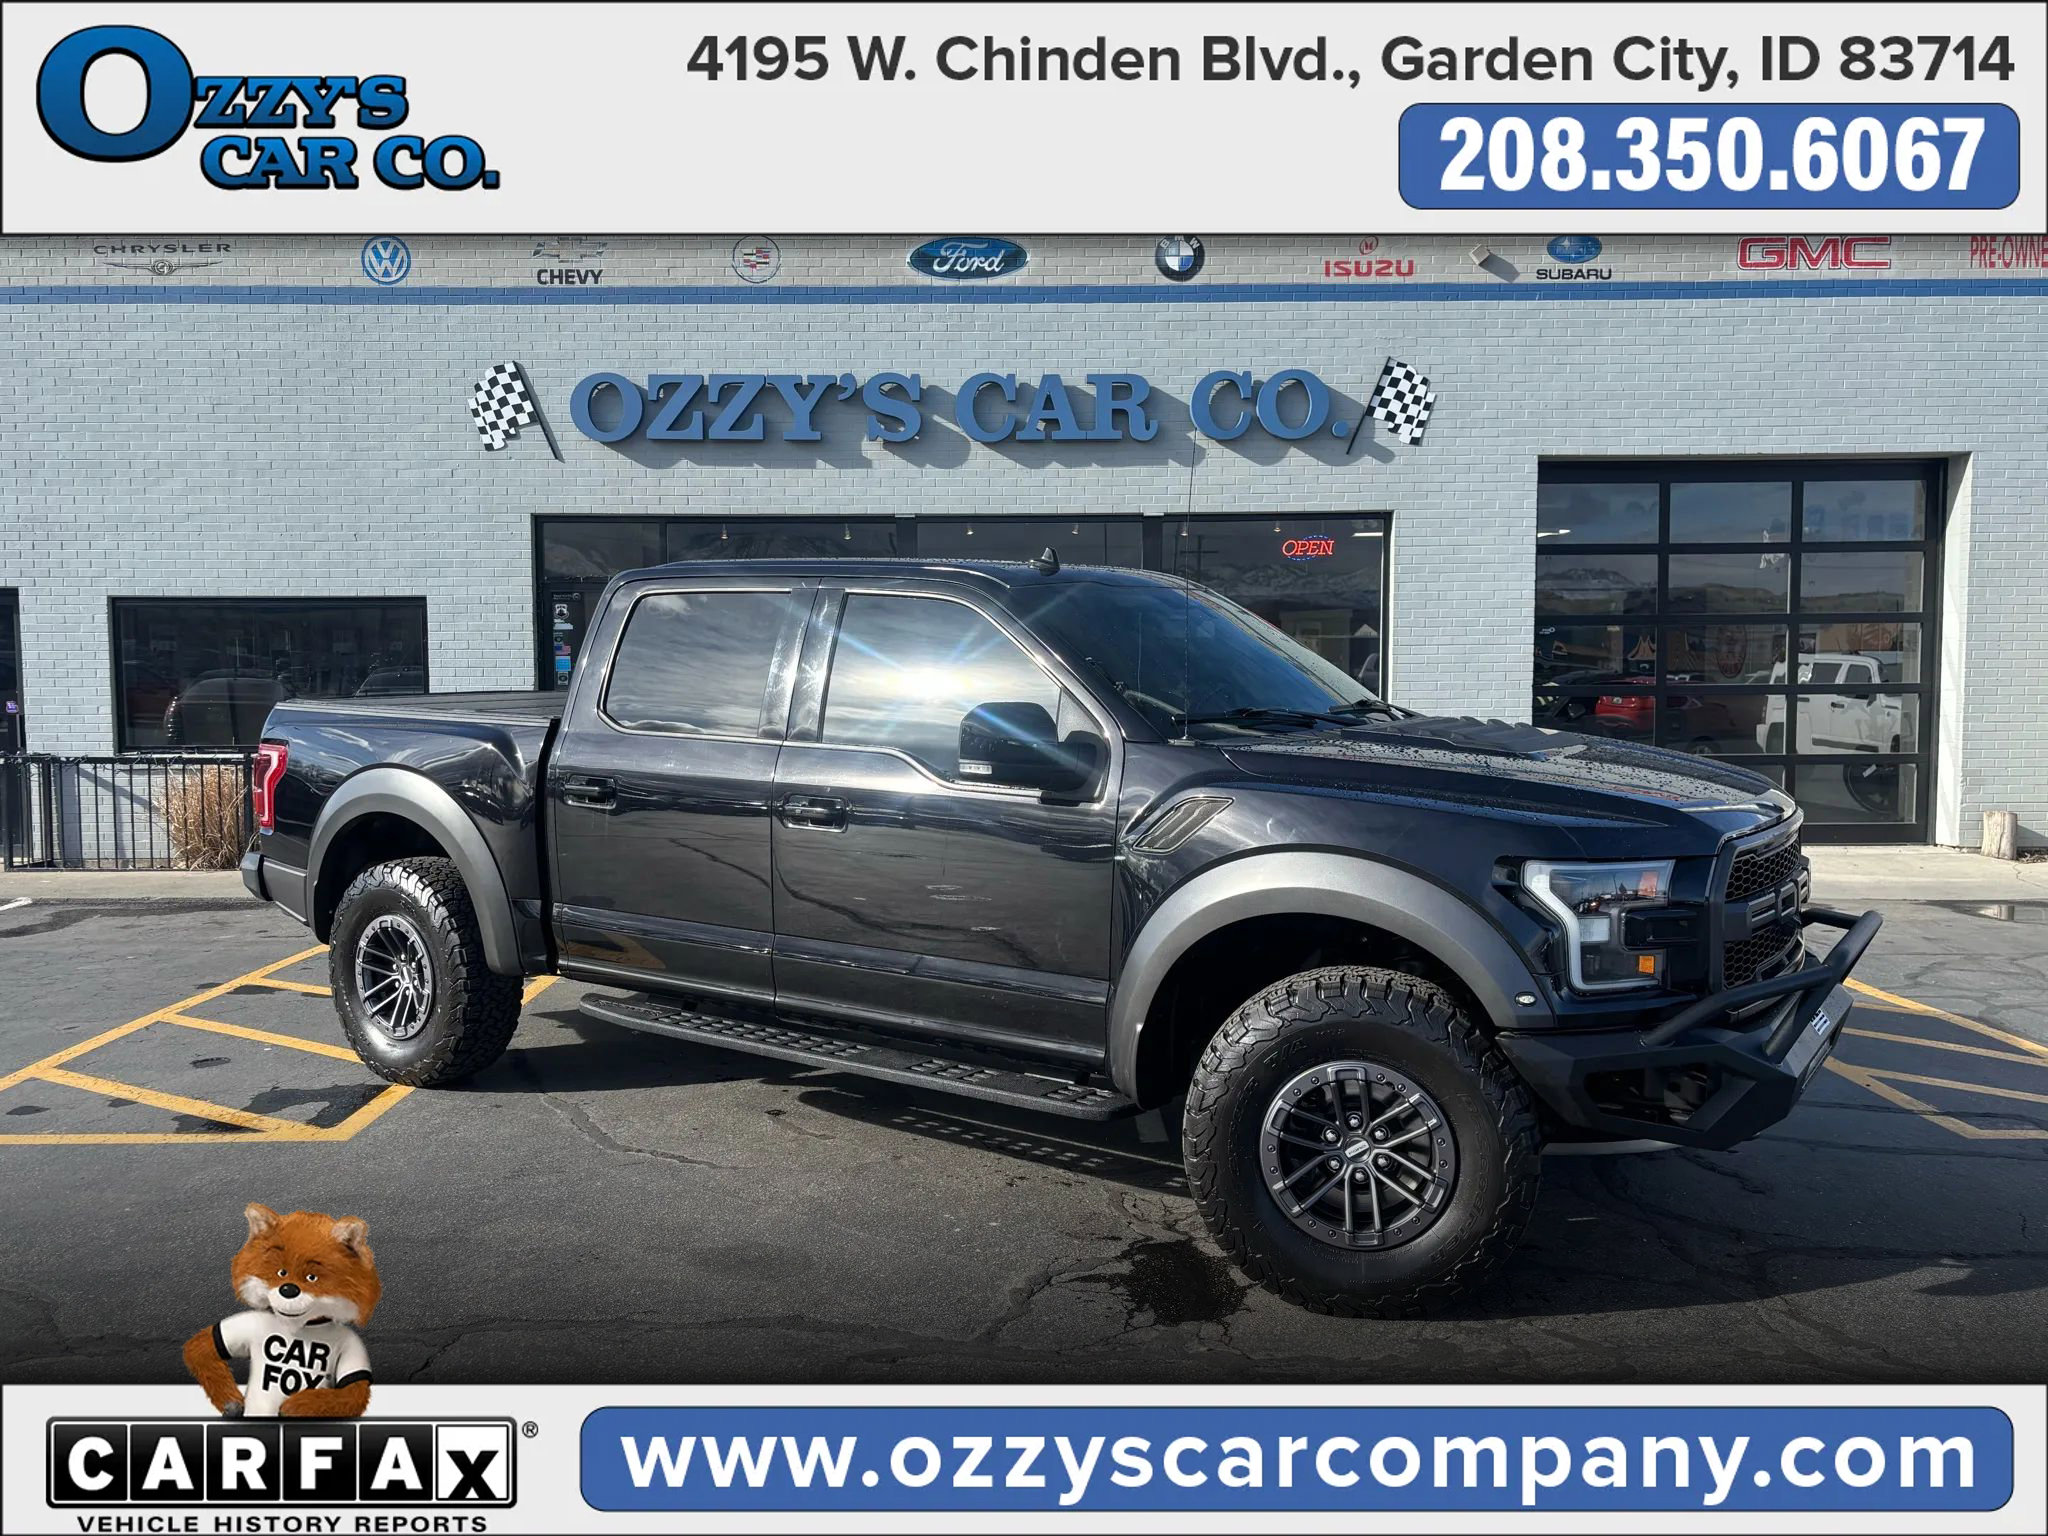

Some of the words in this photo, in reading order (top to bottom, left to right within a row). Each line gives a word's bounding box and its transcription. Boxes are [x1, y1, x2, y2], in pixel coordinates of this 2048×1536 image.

[93, 243, 232, 255] CHRYSLER
[932, 241, 1006, 273] Ford
[1738, 236, 1891, 270] GMC
[536, 268, 604, 285] CHEVY
[1323, 259, 1416, 277] ISUZU
[1535, 268, 1613, 281] SUBARU
[569, 372, 922, 442] OZZY'S
[955, 372, 1159, 442] CAR
[1189, 369, 1350, 440] CO.
[1282, 539, 1335, 556] OPEN
